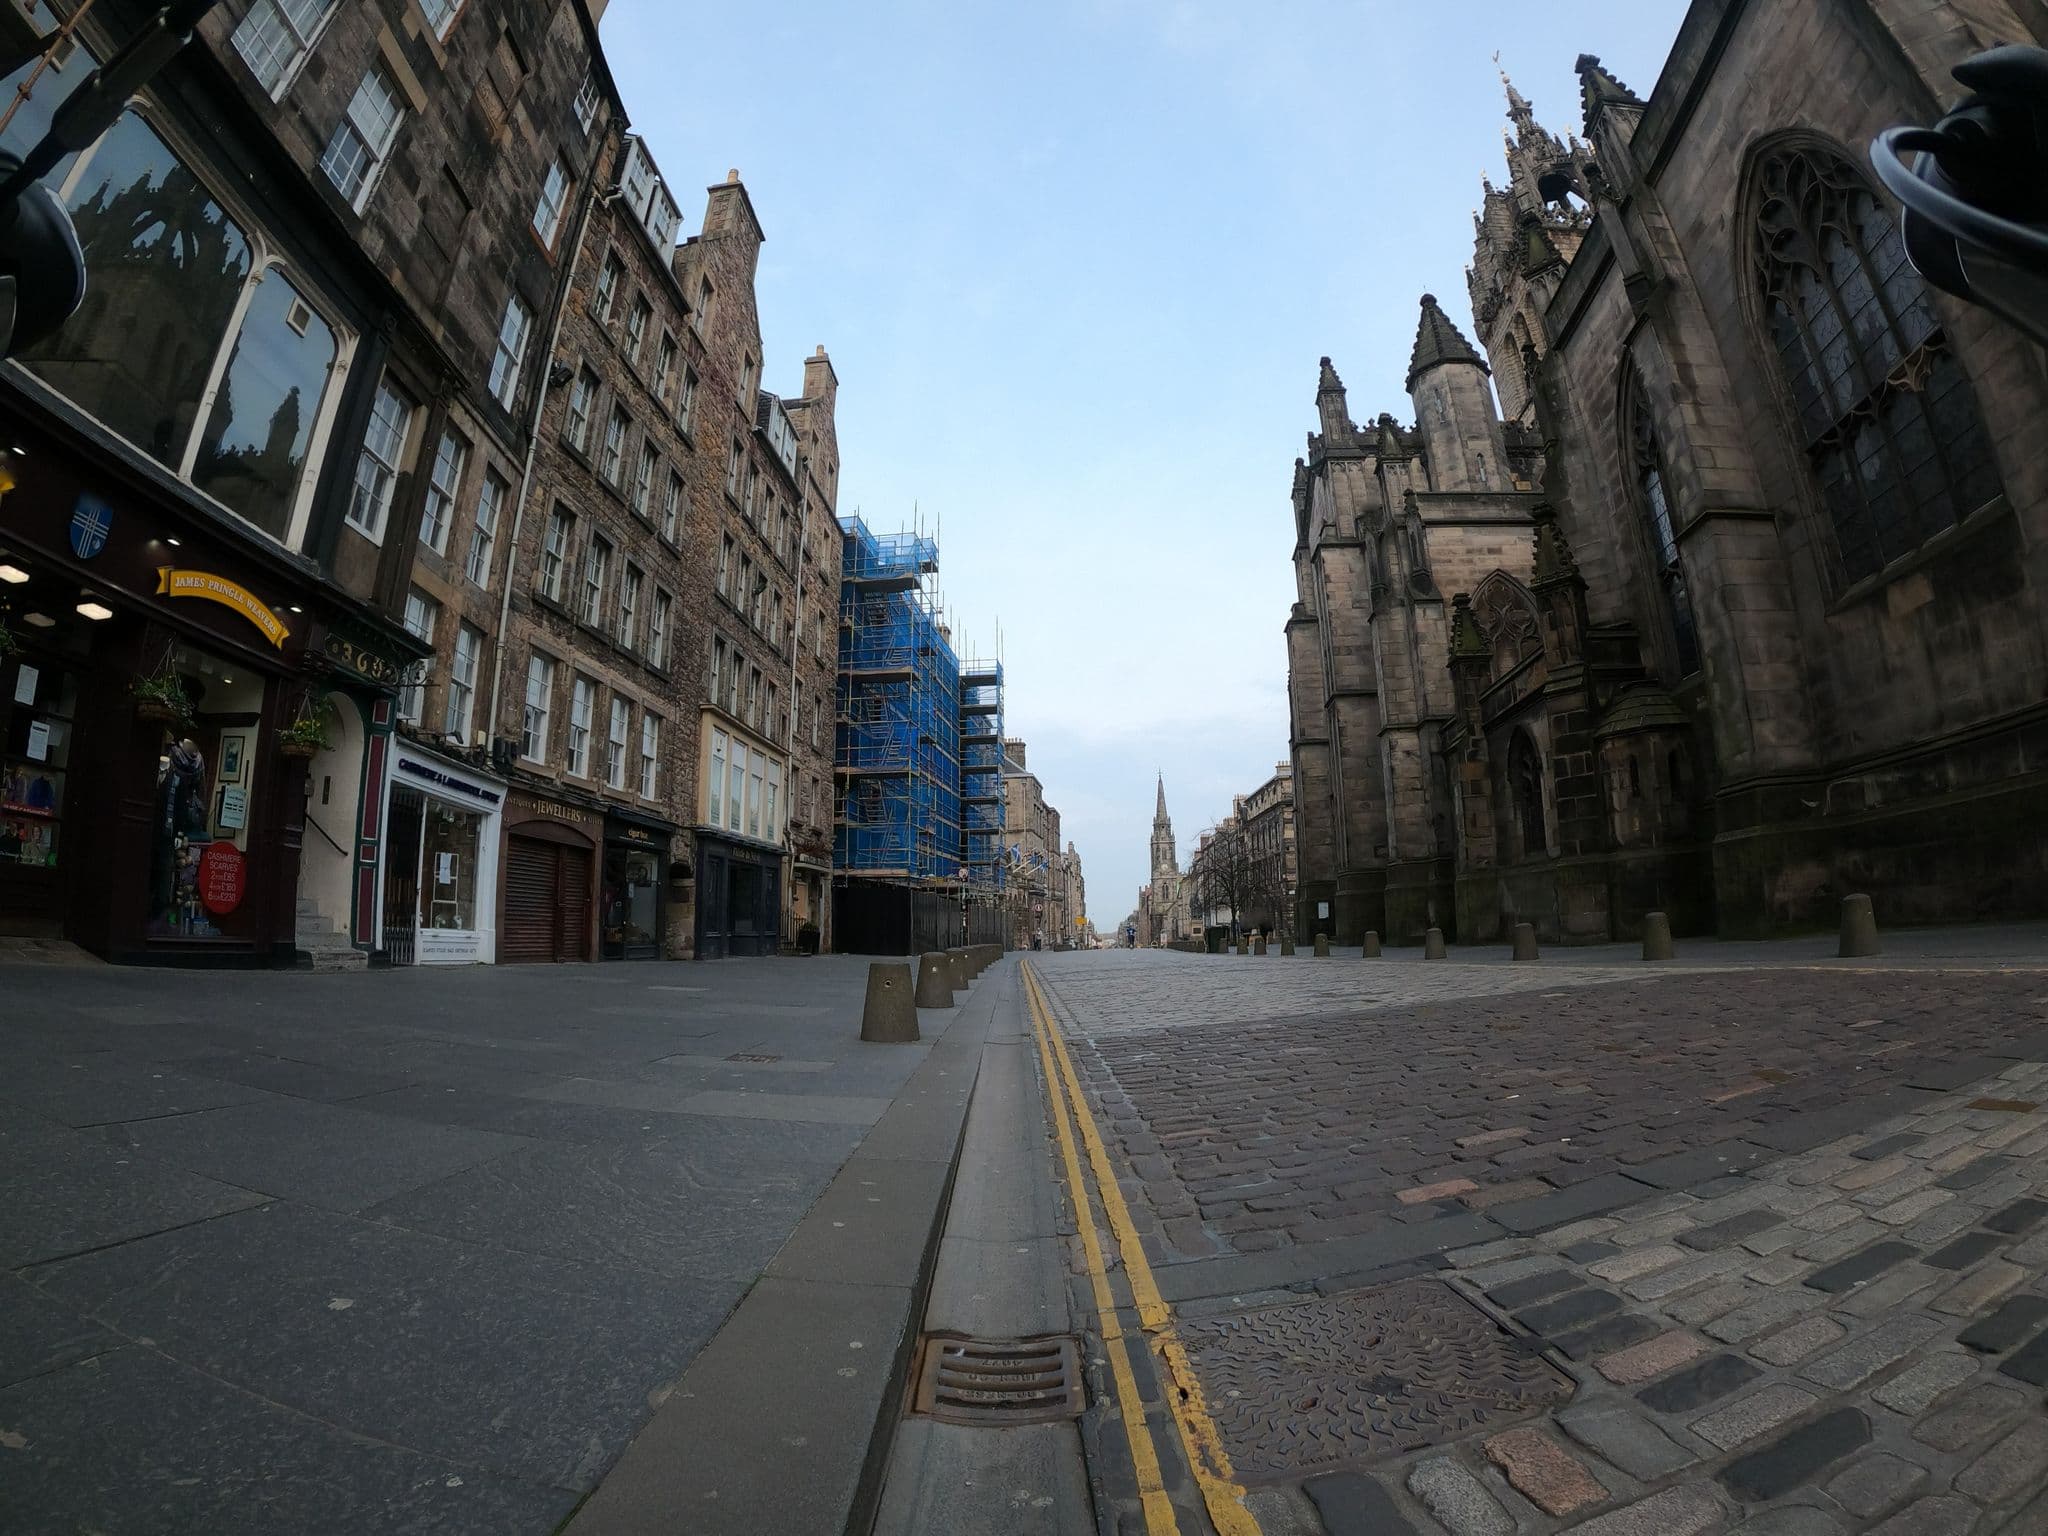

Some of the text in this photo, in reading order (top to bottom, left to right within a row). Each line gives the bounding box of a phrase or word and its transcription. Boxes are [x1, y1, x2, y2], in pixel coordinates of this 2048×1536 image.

[174, 576, 278, 635] JAMES PRINGLE WEAVERS
[537, 799, 581, 822] JEWELLERS
[208, 851, 241, 863] CASHMERE
[209, 861, 238, 873] SCARVES
